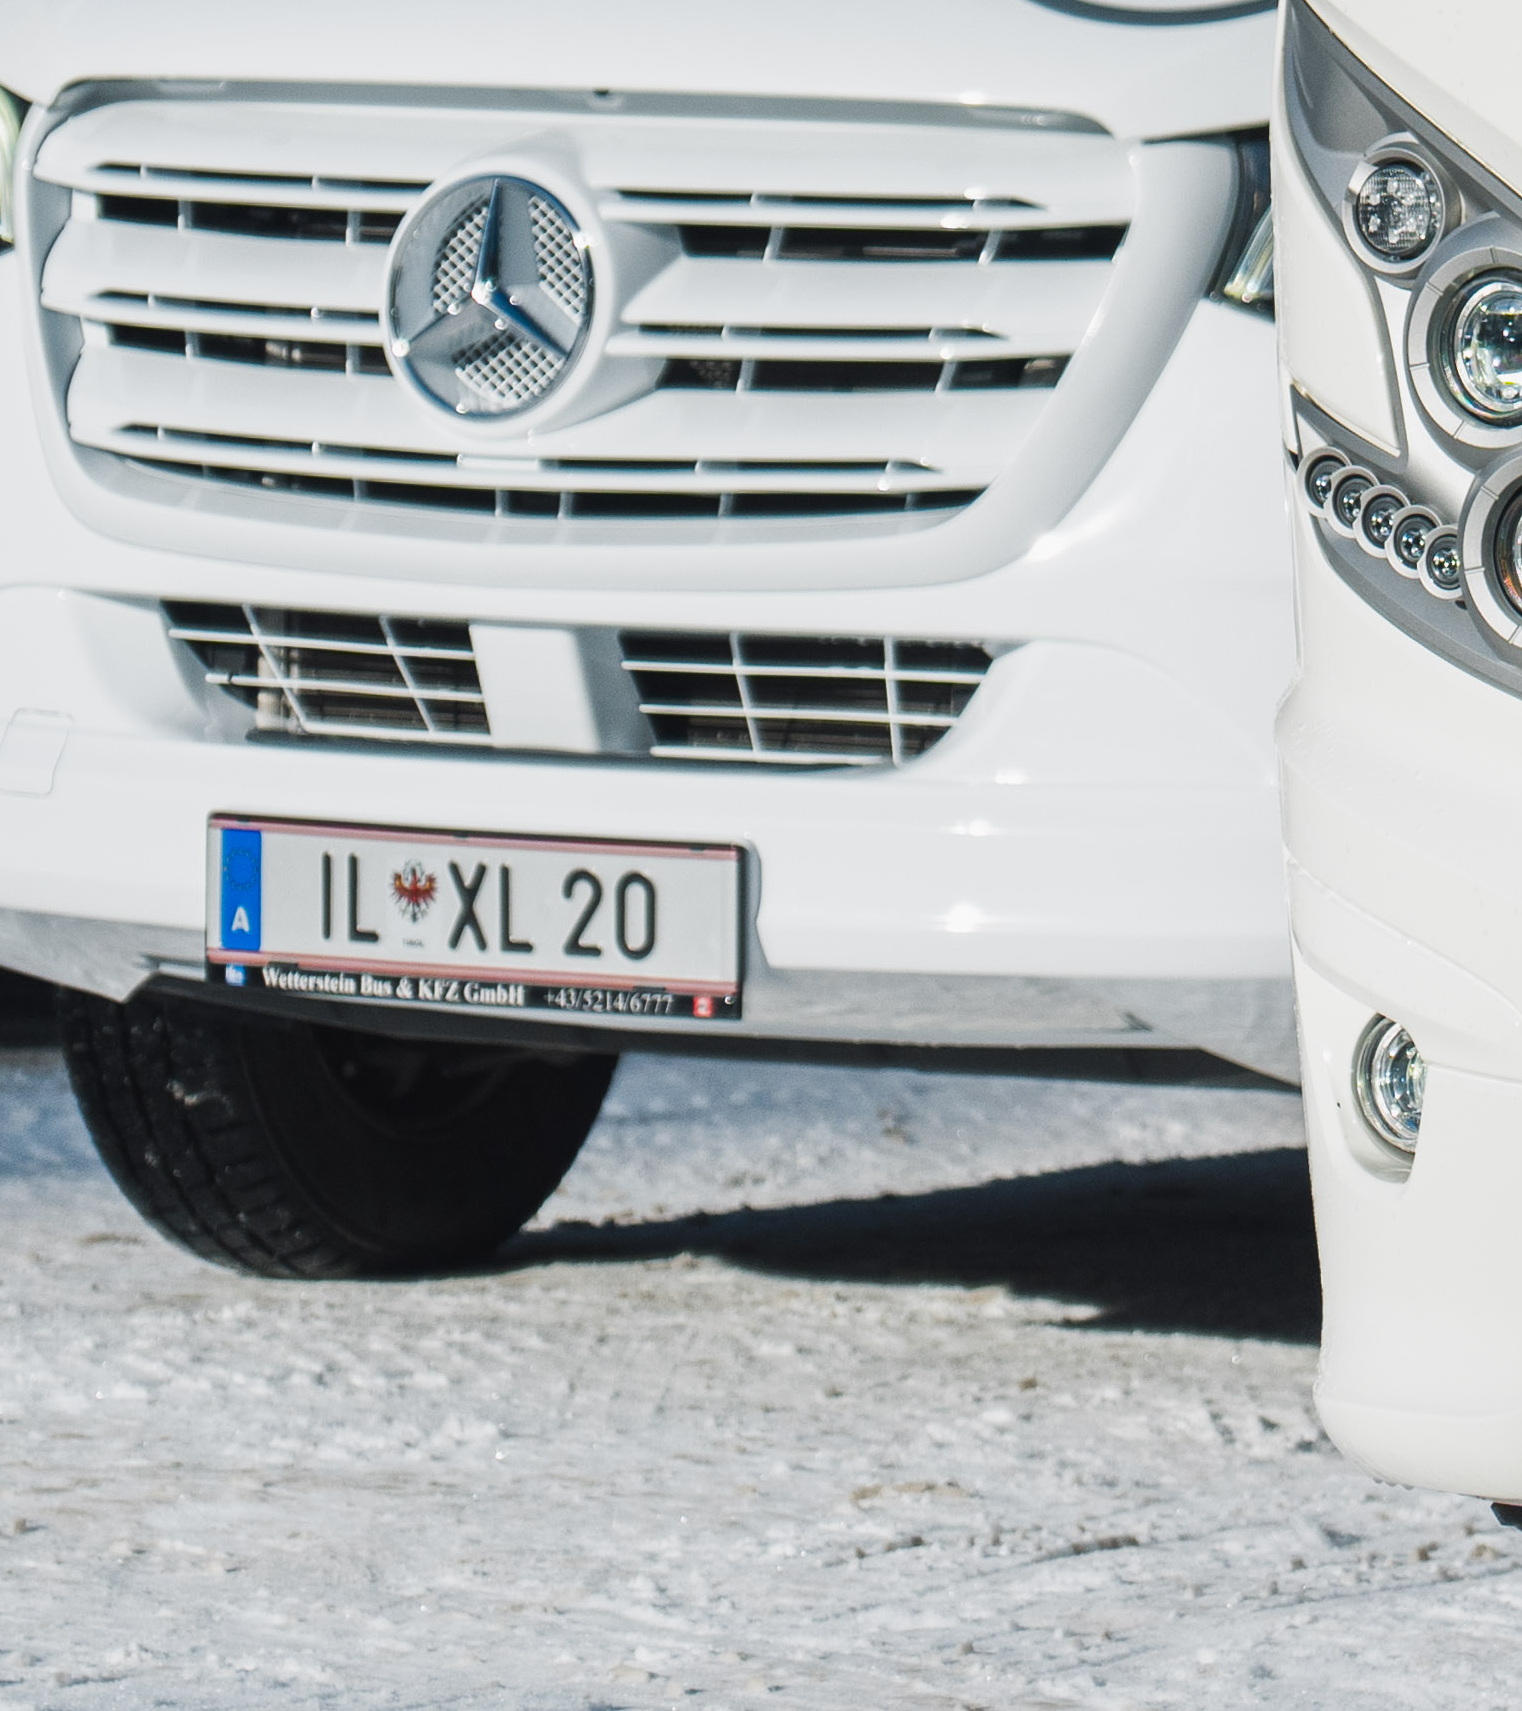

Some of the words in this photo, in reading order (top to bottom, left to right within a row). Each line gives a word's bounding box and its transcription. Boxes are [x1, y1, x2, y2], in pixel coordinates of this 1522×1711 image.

[231, 906, 251, 933] A
[322, 852, 380, 942] IL
[448, 862, 534, 952] XL
[562, 870, 656, 960] 20
[262, 966, 356, 995] Wetterstein
[360, 974, 392, 998] Bus
[396, 976, 414, 999] &
[418, 978, 461, 1002] KFZ
[463, 982, 527, 1007] GmbH
[544, 987, 675, 1015] +43/5214/6777
